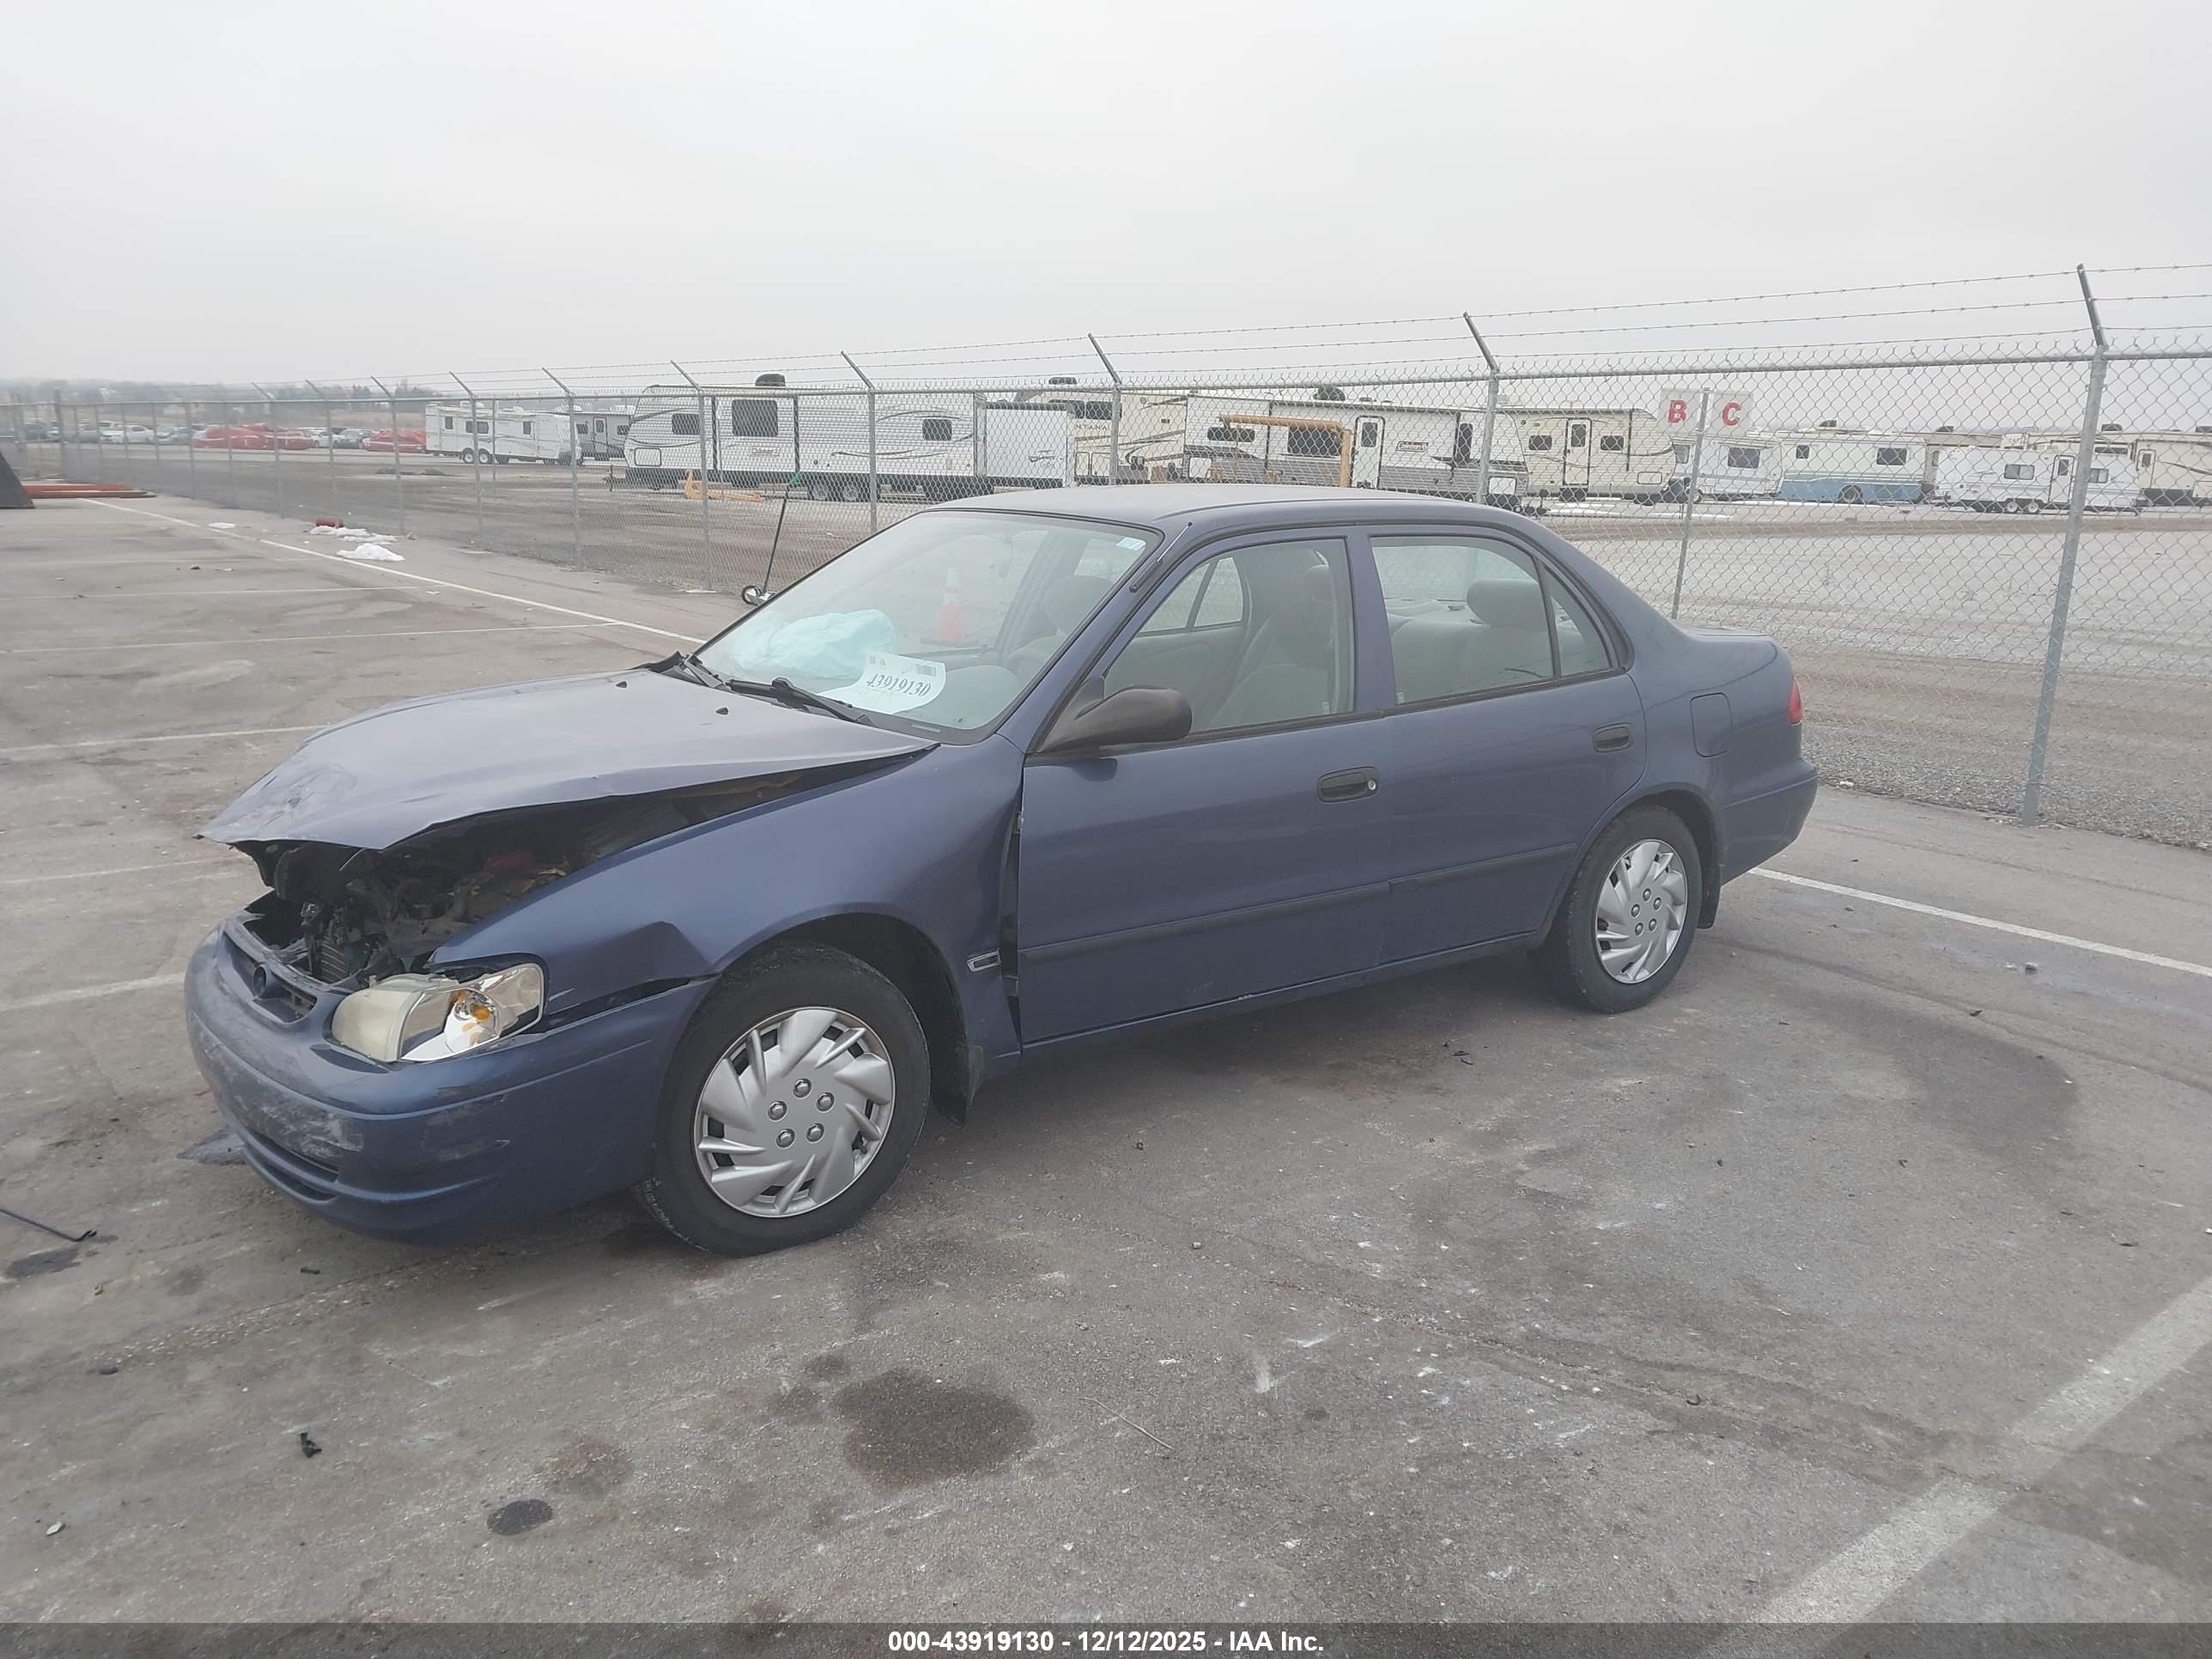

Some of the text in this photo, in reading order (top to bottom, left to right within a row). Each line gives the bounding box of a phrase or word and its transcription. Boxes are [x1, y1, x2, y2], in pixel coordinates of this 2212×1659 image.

[1668, 398, 1687, 423] B
[1722, 401, 1742, 427] C
[866, 673, 932, 697] 43919130
